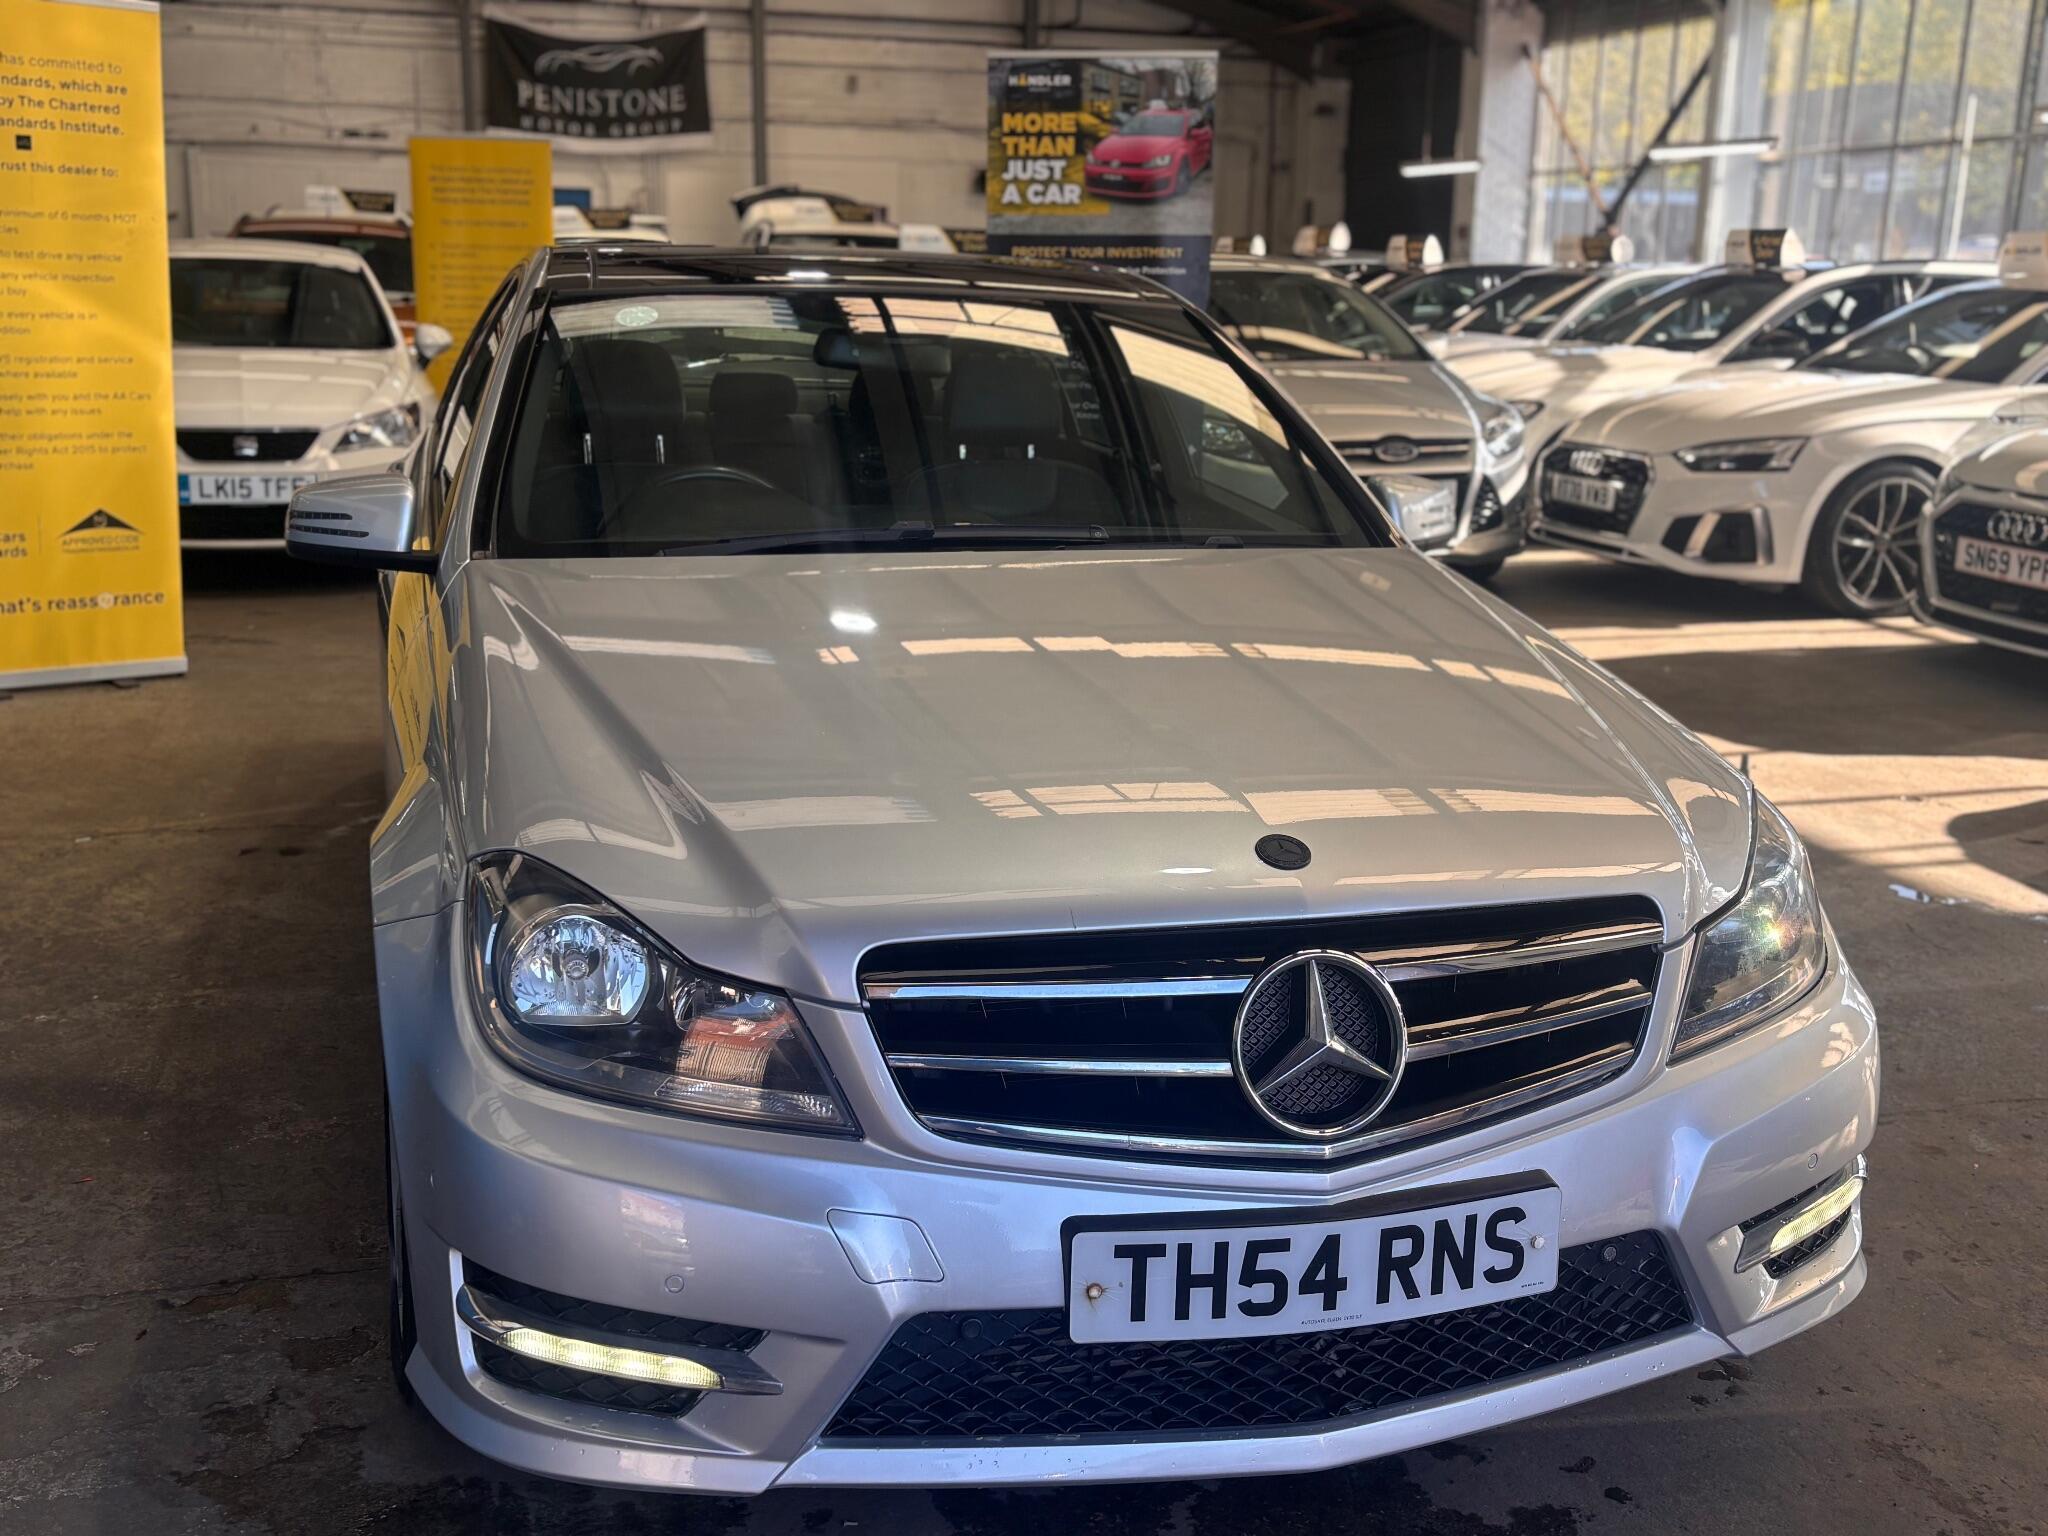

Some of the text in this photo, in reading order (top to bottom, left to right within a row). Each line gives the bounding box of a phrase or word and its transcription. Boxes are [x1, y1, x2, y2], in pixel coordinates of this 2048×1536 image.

[28, 55, 105, 74] committed
[107, 63, 122, 75] to
[59, 79, 102, 93] which
[105, 85, 128, 96] are
[18, 95, 44, 109] The
[48, 97, 121, 115] Chartered
[516, 79, 687, 117] PENISTONE
[60, 119, 125, 136] Institute.
[1002, 112, 1077, 133] MORE
[1002, 136, 1077, 156] THAN
[1, 161, 26, 171] rust
[30, 162, 54, 173] this
[58, 163, 98, 176] dealer
[1002, 159, 1067, 181] JUST
[1002, 183, 1082, 204] A CAR
[61, 211, 68, 220] 6
[71, 213, 110, 223] months
[113, 213, 137, 223] MOT
[13, 250, 34, 259] test
[37, 250, 63, 260] drive
[66, 253, 83, 263] any
[87, 252, 122, 262] vehicle
[1012, 246, 1183, 258] PROTECT YOUR INVESTMENT
[22, 272, 58, 281] vehicle
[61, 273, 115, 284] inspection
[7, 311, 35, 322] every
[39, 311, 75, 320] vehicle
[14, 353, 73, 366] registration
[76, 355, 95, 364] and
[97, 356, 133, 365] service
[33, 369, 78, 379] available
[26, 392, 48, 401] with
[51, 393, 69, 402] you
[73, 392, 91, 400] and
[94, 391, 109, 400] the
[113, 391, 125, 400] AA
[129, 391, 152, 401] Cars
[26, 407, 47, 416] with
[51, 408, 69, 417] any
[71, 407, 101, 416] issues
[86, 431, 113, 440] under
[117, 430, 133, 439] the
[15, 446, 49, 457] Rights
[52, 446, 69, 455] Act
[111, 446, 146, 456] protect
[1965, 543, 2010, 575] SN69
[47, 591, 164, 612] reassrance
[1114, 1206, 1527, 1322] TH54 RNS
